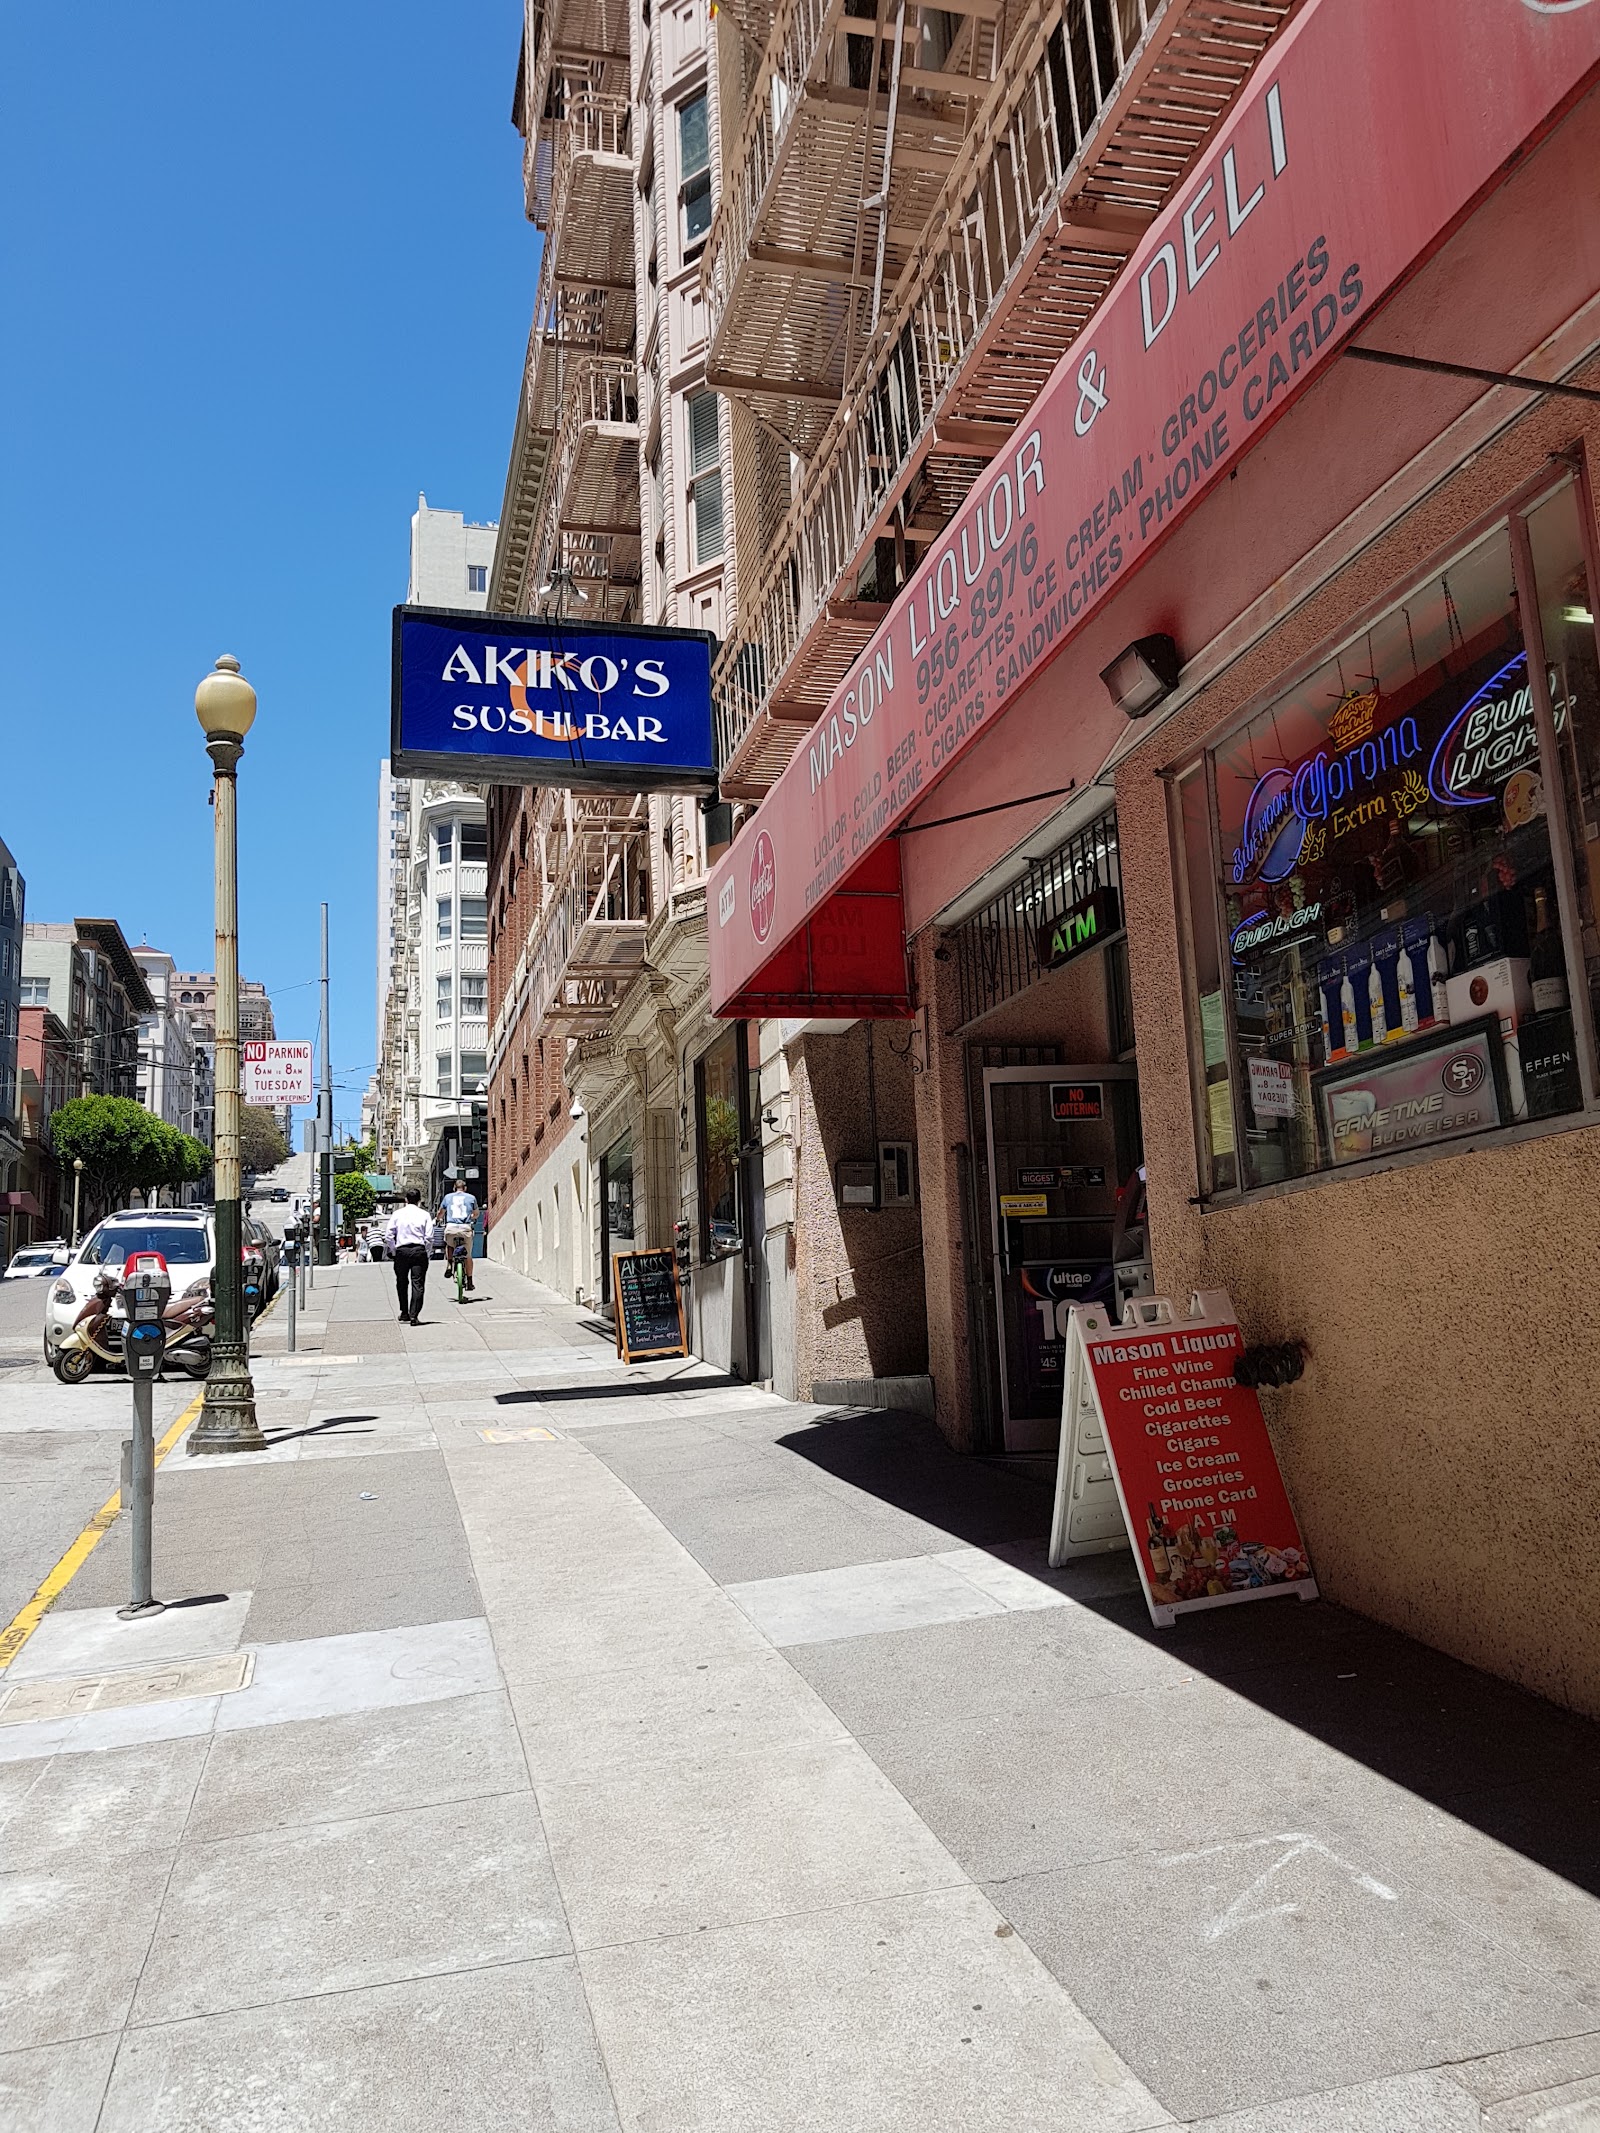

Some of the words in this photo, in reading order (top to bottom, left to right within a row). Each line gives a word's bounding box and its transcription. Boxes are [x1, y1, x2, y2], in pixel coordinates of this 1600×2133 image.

[808, 634, 896, 796] MASON
[907, 428, 1046, 662] LIQUOR
[1073, 349, 1110, 438] &
[1138, 79, 1289, 353] DELI
[813, 812, 848, 868] LIQUOR
[853, 771, 882, 821] COLD
[886, 729, 916, 782] BEER
[924, 611, 1015, 737] CIGARETTES
[1027, 559, 1057, 617] ICE
[1065, 454, 1144, 571] CREAM
[1161, 235, 1329, 457] GROCERIES
[851, 759, 923, 857] CHAMPAGNE
[931, 689, 985, 768] CIGARS
[995, 533, 1123, 698] SANDWICHES
[1138, 410, 1230, 541] PHONE
[1242, 263, 1364, 421] CARDS
[916, 522, 1039, 704] 956-8976
[441, 643, 671, 698] AKIKO'S
[452, 704, 572, 738] SUSHI
[585, 713, 669, 743] BAR
[1291, 715, 1423, 820] Corona
[1331, 795, 1388, 839] Extra
[1050, 904, 1097, 960] ATM
[1233, 920, 1274, 954] BUD
[1269, 1029, 1293, 1043] SUPER
[1294, 1022, 1316, 1035] BOWL
[247, 1043, 264, 1060] NO
[268, 1047, 309, 1059] PARKING
[1525, 1050, 1571, 1073] EFFEN
[254, 1064, 272, 1075] 6AM
[285, 1063, 302, 1075] 8AM
[254, 1080, 302, 1091] TUESDAY
[1069, 1088, 1085, 1101] NO
[1054, 1102, 1100, 1117] LOITERING
[1333, 1107, 1391, 1138] GAME
[1393, 1092, 1444, 1121] TIME
[1372, 1109, 1480, 1148] BUDWEISER
[1022, 1173, 1055, 1183] BIGGEST
[1092, 1340, 1167, 1366] Mason
[1170, 1331, 1237, 1357] Liquor
[1133, 1364, 1169, 1381] Fine
[1175, 1359, 1214, 1375] Wine
[1119, 1381, 1175, 1402] Chilled
[1180, 1376, 1238, 1394] Champ
[1143, 1401, 1181, 1418] Cold
[1185, 1395, 1222, 1412] Beer
[1145, 1413, 1232, 1437] Cigarettes
[1166, 1434, 1221, 1454] Cigars
[1156, 1458, 1183, 1474] Ice
[1186, 1451, 1241, 1469] Cream
[1162, 1468, 1245, 1493] Groceries
[1160, 1495, 1214, 1513] Phone
[1218, 1485, 1257, 1502] Card
